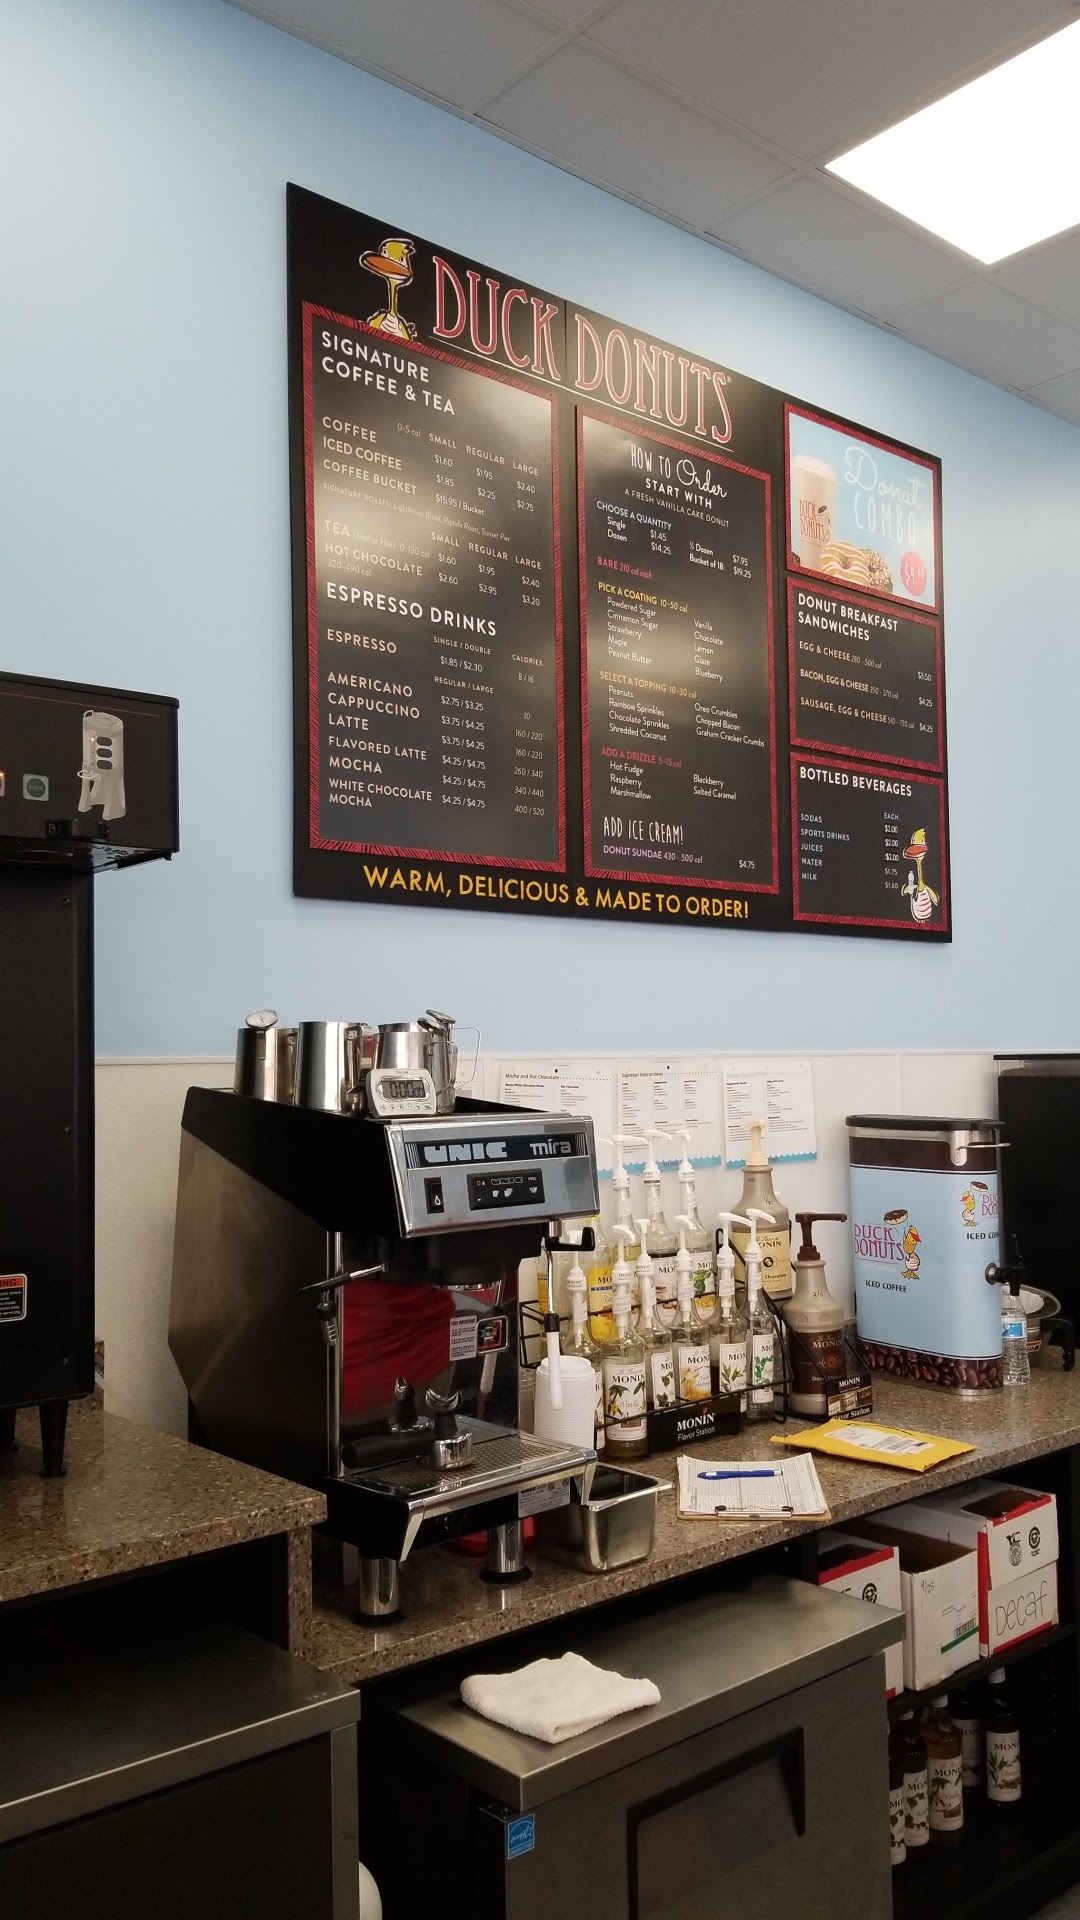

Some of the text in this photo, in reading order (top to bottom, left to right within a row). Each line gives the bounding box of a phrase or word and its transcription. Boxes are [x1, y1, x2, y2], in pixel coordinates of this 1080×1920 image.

[322, 331, 429, 383] SIGNATURE
[433, 256, 733, 444] DUCK DONUTS
[322, 356, 455, 415] COFFEE & TEA
[323, 416, 376, 443] COFFEE
[323, 436, 402, 471] ICED COFFEE
[429, 433, 539, 476] SMALL REGULAR LARGE
[631, 443, 727, 498] HOW TO Order
[845, 446, 926, 509] Donut
[323, 459, 484, 516] COFFEE BUCKET $15.95 Bucket
[646, 478, 712, 509] START WITH
[596, 500, 672, 531] CHOOSE QUANTITY
[632, 490, 729, 528] FRESH VANILLA CAKE DONUT
[854, 492, 916, 546] COMBO
[607, 516, 626, 531] Single
[324, 520, 495, 576] TEA $1.95
[325, 542, 423, 576] HOT CHOCOLATE
[431, 532, 541, 570] SMALL REGULAR LARGE
[689, 553, 709, 566] Bucket
[598, 581, 657, 605] PICK COATING
[327, 582, 496, 636] ESPRESSO DRINKS
[607, 596, 713, 631] Powdered Sugar Vanilla
[798, 593, 898, 632] DONUT BREAKFAST
[607, 609, 723, 645] Cinnamon Sugar Chocolate
[607, 621, 714, 655] Strawberry Lemon
[798, 611, 869, 641] SANDWICHES
[327, 628, 458, 667] ESPRESSO $1.85
[433, 636, 543, 666] SINGLE DOUBLE CALORIES
[607, 634, 628, 647] Maple
[608, 646, 723, 683] Peanut Butter Blueberry
[799, 640, 932, 682] EGG CHEESE $3.50
[327, 671, 412, 697] AMERICANO
[434, 676, 493, 694] REGULAR LARGE
[599, 670, 667, 692] SELECT TOPPING
[800, 668, 869, 692] BACON, CHEESE
[328, 692, 420, 719] CAPPUCCINO
[608, 684, 738, 719] Peanuts Crumbles
[609, 697, 740, 731] Rainbow Sprinkles Chopped Bacon
[800, 697, 887, 723] SAUSAGE, EGG CHEESE
[329, 713, 369, 730] LATTE
[609, 710, 765, 747] Chocolate Sprinkles Graham Cracker Crumbs
[609, 722, 667, 741] Shredded Coconut
[329, 735, 427, 760] FLAVORED LATTE
[627, 751, 656, 764] DRIZZLE
[329, 755, 382, 774] MOCHA
[624, 762, 724, 789] Fudge Blackberry
[329, 778, 432, 801] WHITE CHOCOLATE
[610, 773, 736, 800] Raspberry Salted Caramel
[610, 786, 651, 800] Marshmallow
[800, 766, 912, 797] BOTTLED BEVERAGES
[329, 793, 372, 807] MOCHA
[800, 813, 822, 823] SODAS
[884, 812, 899, 820] EACH
[603, 816, 683, 845] ADD ICE CREAM!
[800, 828, 850, 841] SPORTS DRINKS
[603, 845, 631, 856] DONUT
[632, 848, 662, 859] SUNDAE
[800, 843, 823, 852] JUICES
[801, 858, 822, 866] WATER
[801, 872, 817, 880] MILK
[362, 865, 749, 918] WARM, DELICIOUS & MADE TO ORDER!
[423, 1138, 572, 1163] UNIC mira
[853, 1223, 895, 1242] DUCK
[966, 1232, 986, 1240] ICED
[853, 1236, 905, 1261] DONUTS
[865, 1280, 908, 1293] ICED COFFEE
[838, 1376, 861, 1389] MONIN
[676, 1412, 715, 1432] MONIN
[677, 1426, 716, 1442] Flavor Station
